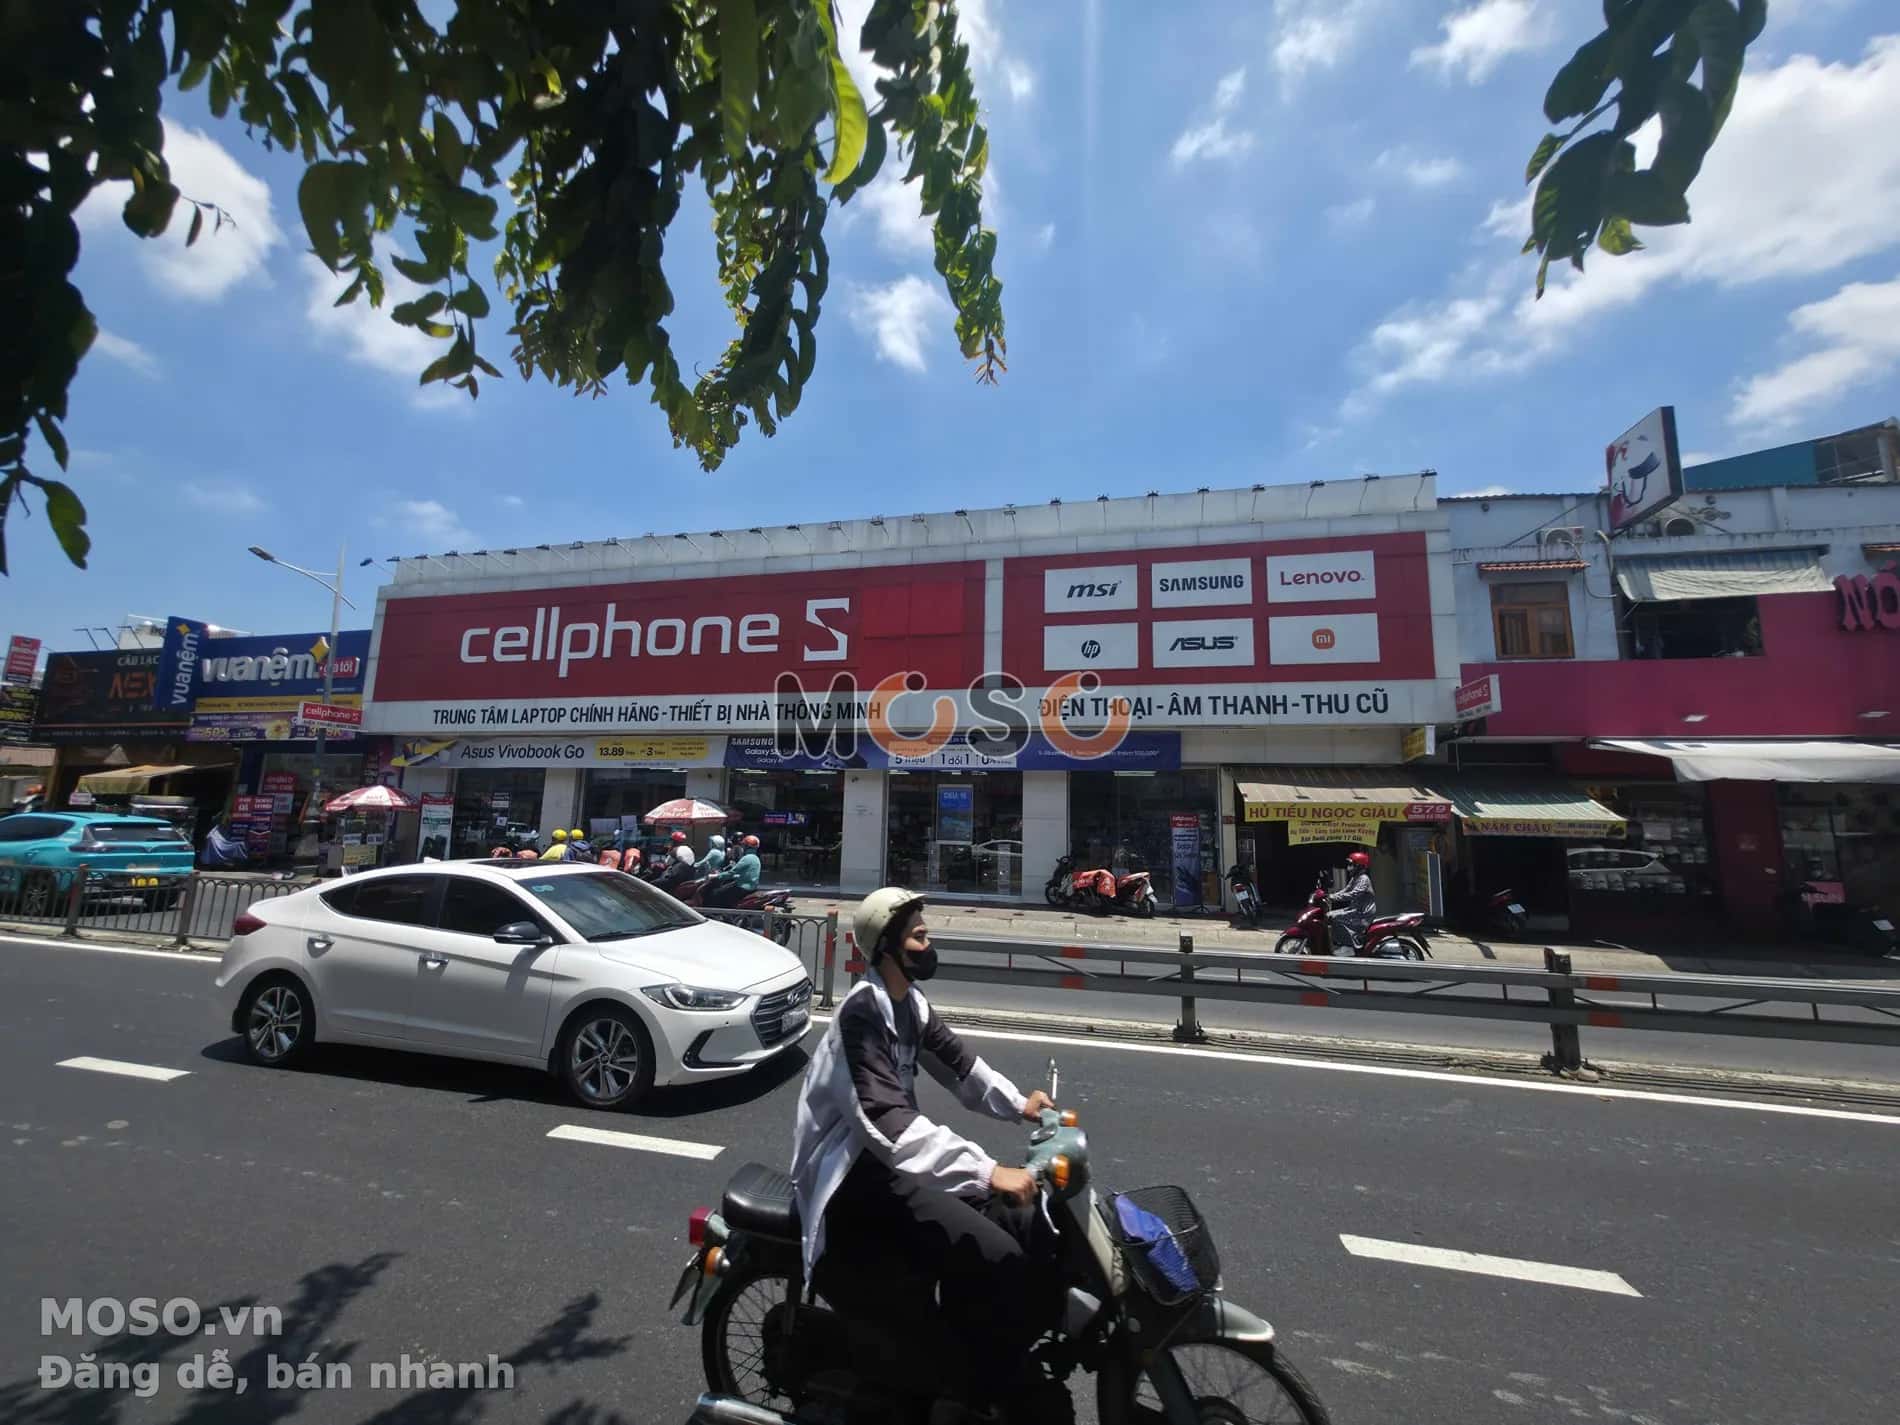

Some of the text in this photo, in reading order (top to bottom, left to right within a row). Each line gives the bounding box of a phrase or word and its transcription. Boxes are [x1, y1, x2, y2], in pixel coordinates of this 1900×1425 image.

[1159, 574, 1244, 592] SAMSUNG
[1280, 570, 1361, 586] Lenovo
[1067, 582, 1119, 598] msi
[1081, 640, 1101, 659] hp
[1169, 636, 1236, 652] ASUS
[171, 632, 200, 705] vuanệm
[433, 708, 476, 724] TRUNG
[481, 706, 508, 724] TÂM
[512, 707, 566, 724] LAPTOP
[570, 704, 614, 722] CHÍNH
[716, 703, 731, 724] BỊ
[736, 700, 770, 720] NHÀ
[775, 700, 831, 720] THÔNG
[837, 702, 881, 720] MINH
[1038, 694, 1085, 720] ĐIỆN
[1091, 697, 1152, 720] THOẠI
[1168, 692, 1202, 716] ÂM
[1208, 695, 1288, 715] THANH
[1301, 693, 1349, 714] THU
[1356, 688, 1389, 713] CŨ
[731, 737, 774, 746] SAMSUNG
[461, 743, 585, 759] Asus Vivobook Go
[599, 747, 625, 756] 13.89
